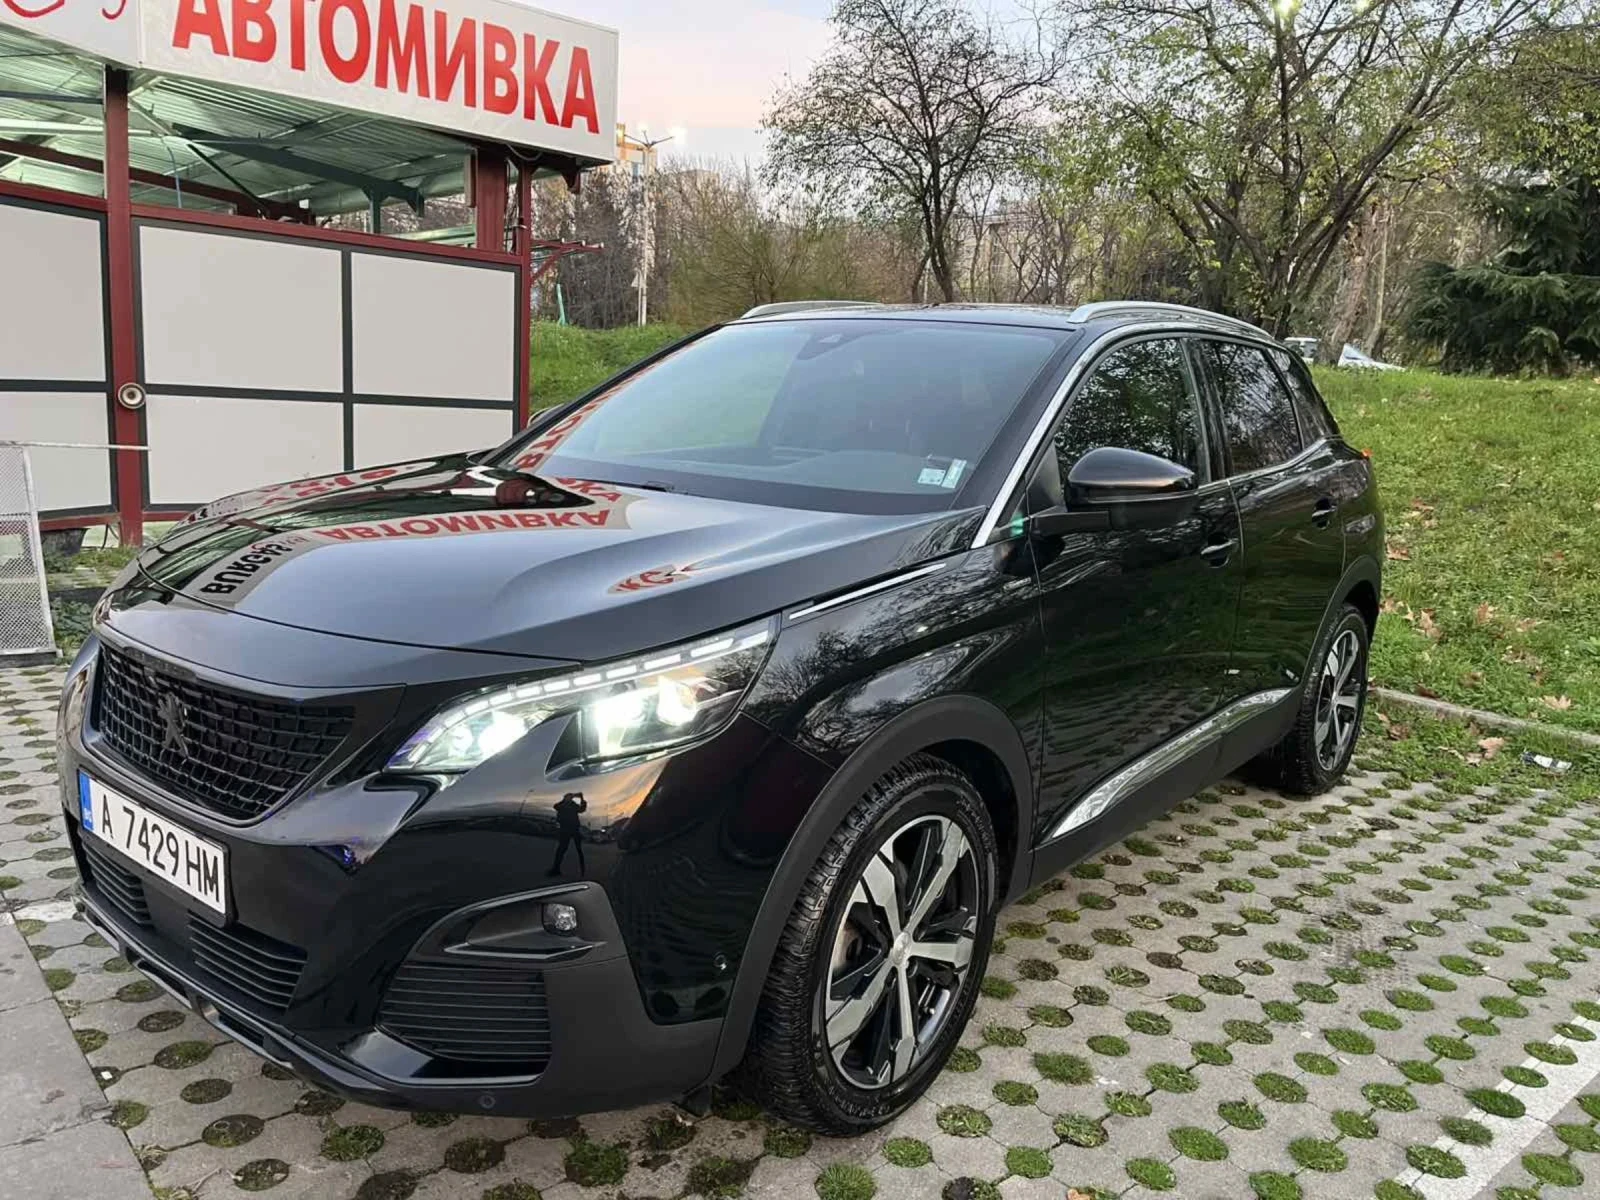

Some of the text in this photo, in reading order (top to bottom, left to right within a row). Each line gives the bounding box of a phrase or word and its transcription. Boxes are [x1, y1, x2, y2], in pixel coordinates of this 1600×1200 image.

[172, 0, 600, 134] АВТОМИВКА
[101, 793, 114, 839] A
[122, 805, 180, 877] 7429
